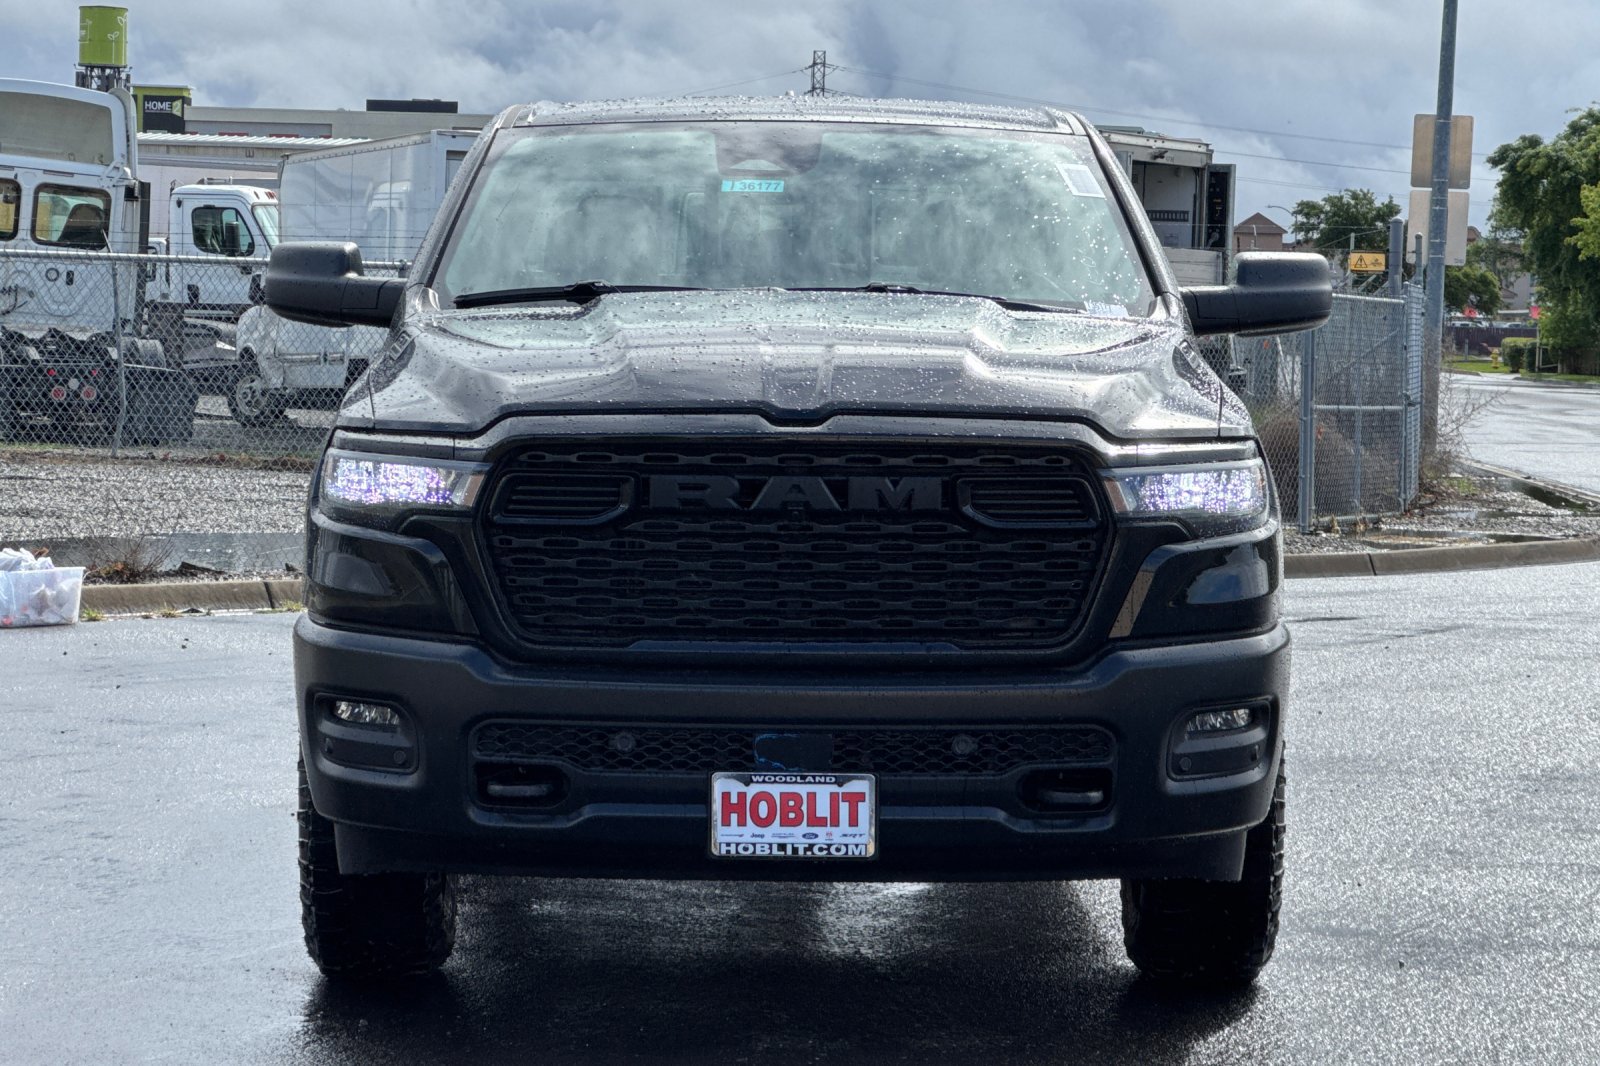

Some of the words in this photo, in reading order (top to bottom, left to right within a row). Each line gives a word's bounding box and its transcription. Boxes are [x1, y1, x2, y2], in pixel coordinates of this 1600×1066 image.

[649, 475, 942, 510] RAM
[751, 775, 836, 783] WOODLAND
[721, 791, 866, 828] HOBLIT
[720, 843, 866, 856] HOBLIT.COM
